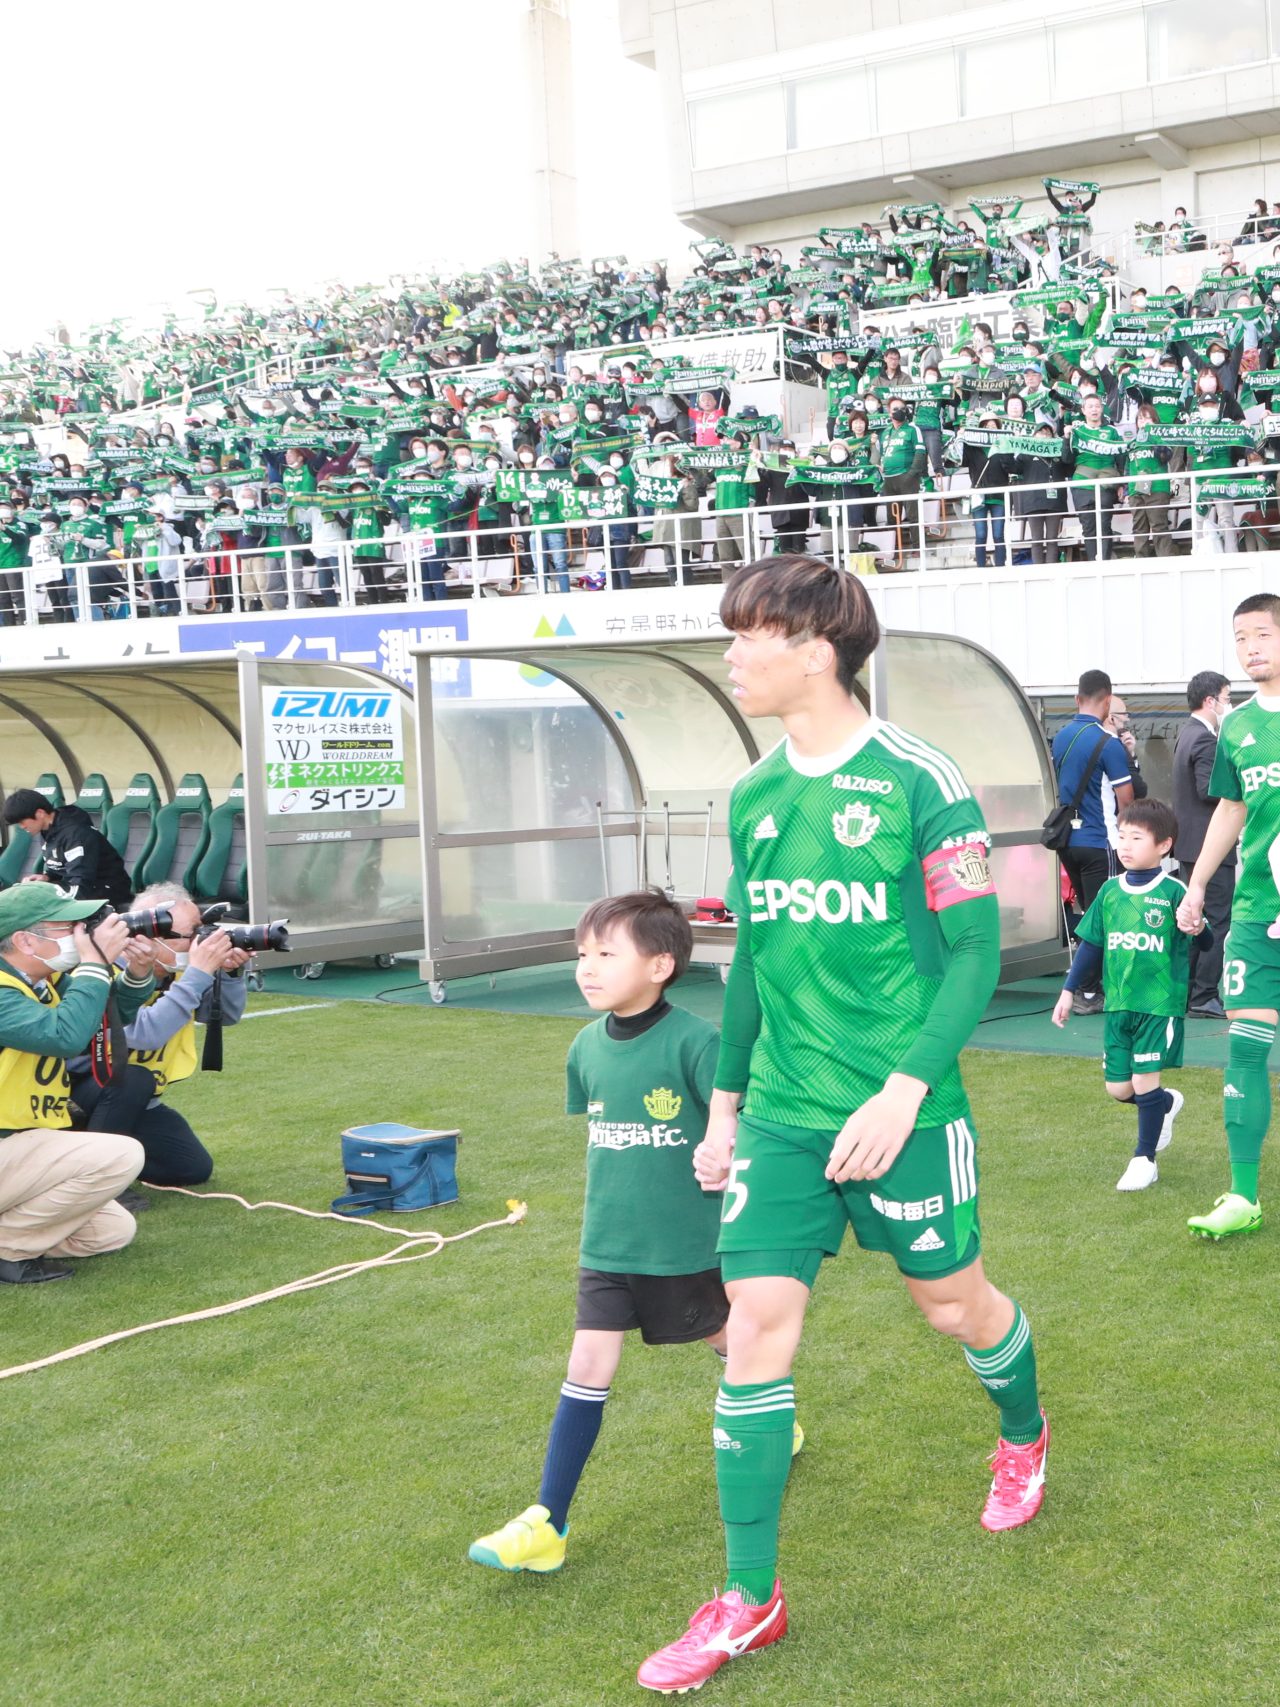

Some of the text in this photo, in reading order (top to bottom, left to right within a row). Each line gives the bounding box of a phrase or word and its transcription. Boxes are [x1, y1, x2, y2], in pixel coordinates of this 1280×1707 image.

[1179, 324, 1225, 337] YAMAGA
[1009, 440, 1050, 455] YAMAGA
[687, 455, 730, 467] YAMAGA
[499, 471, 516, 489] 14
[562, 489, 576, 507] 15
[272, 691, 392, 717] IZUMI
[272, 723, 393, 735] マクセルイズミ株式会社
[298, 763, 403, 779] ネクストリンクス
[832, 774, 893, 795] RAZUSO
[310, 788, 397, 810] ダイシン
[747, 879, 888, 924] EPSON
[1144, 896, 1171, 906] RAZUSO
[1108, 932, 1163, 952] EPSON
[30, 1095, 68, 1119] PRE
[910, 1240, 945, 1252] adidas
